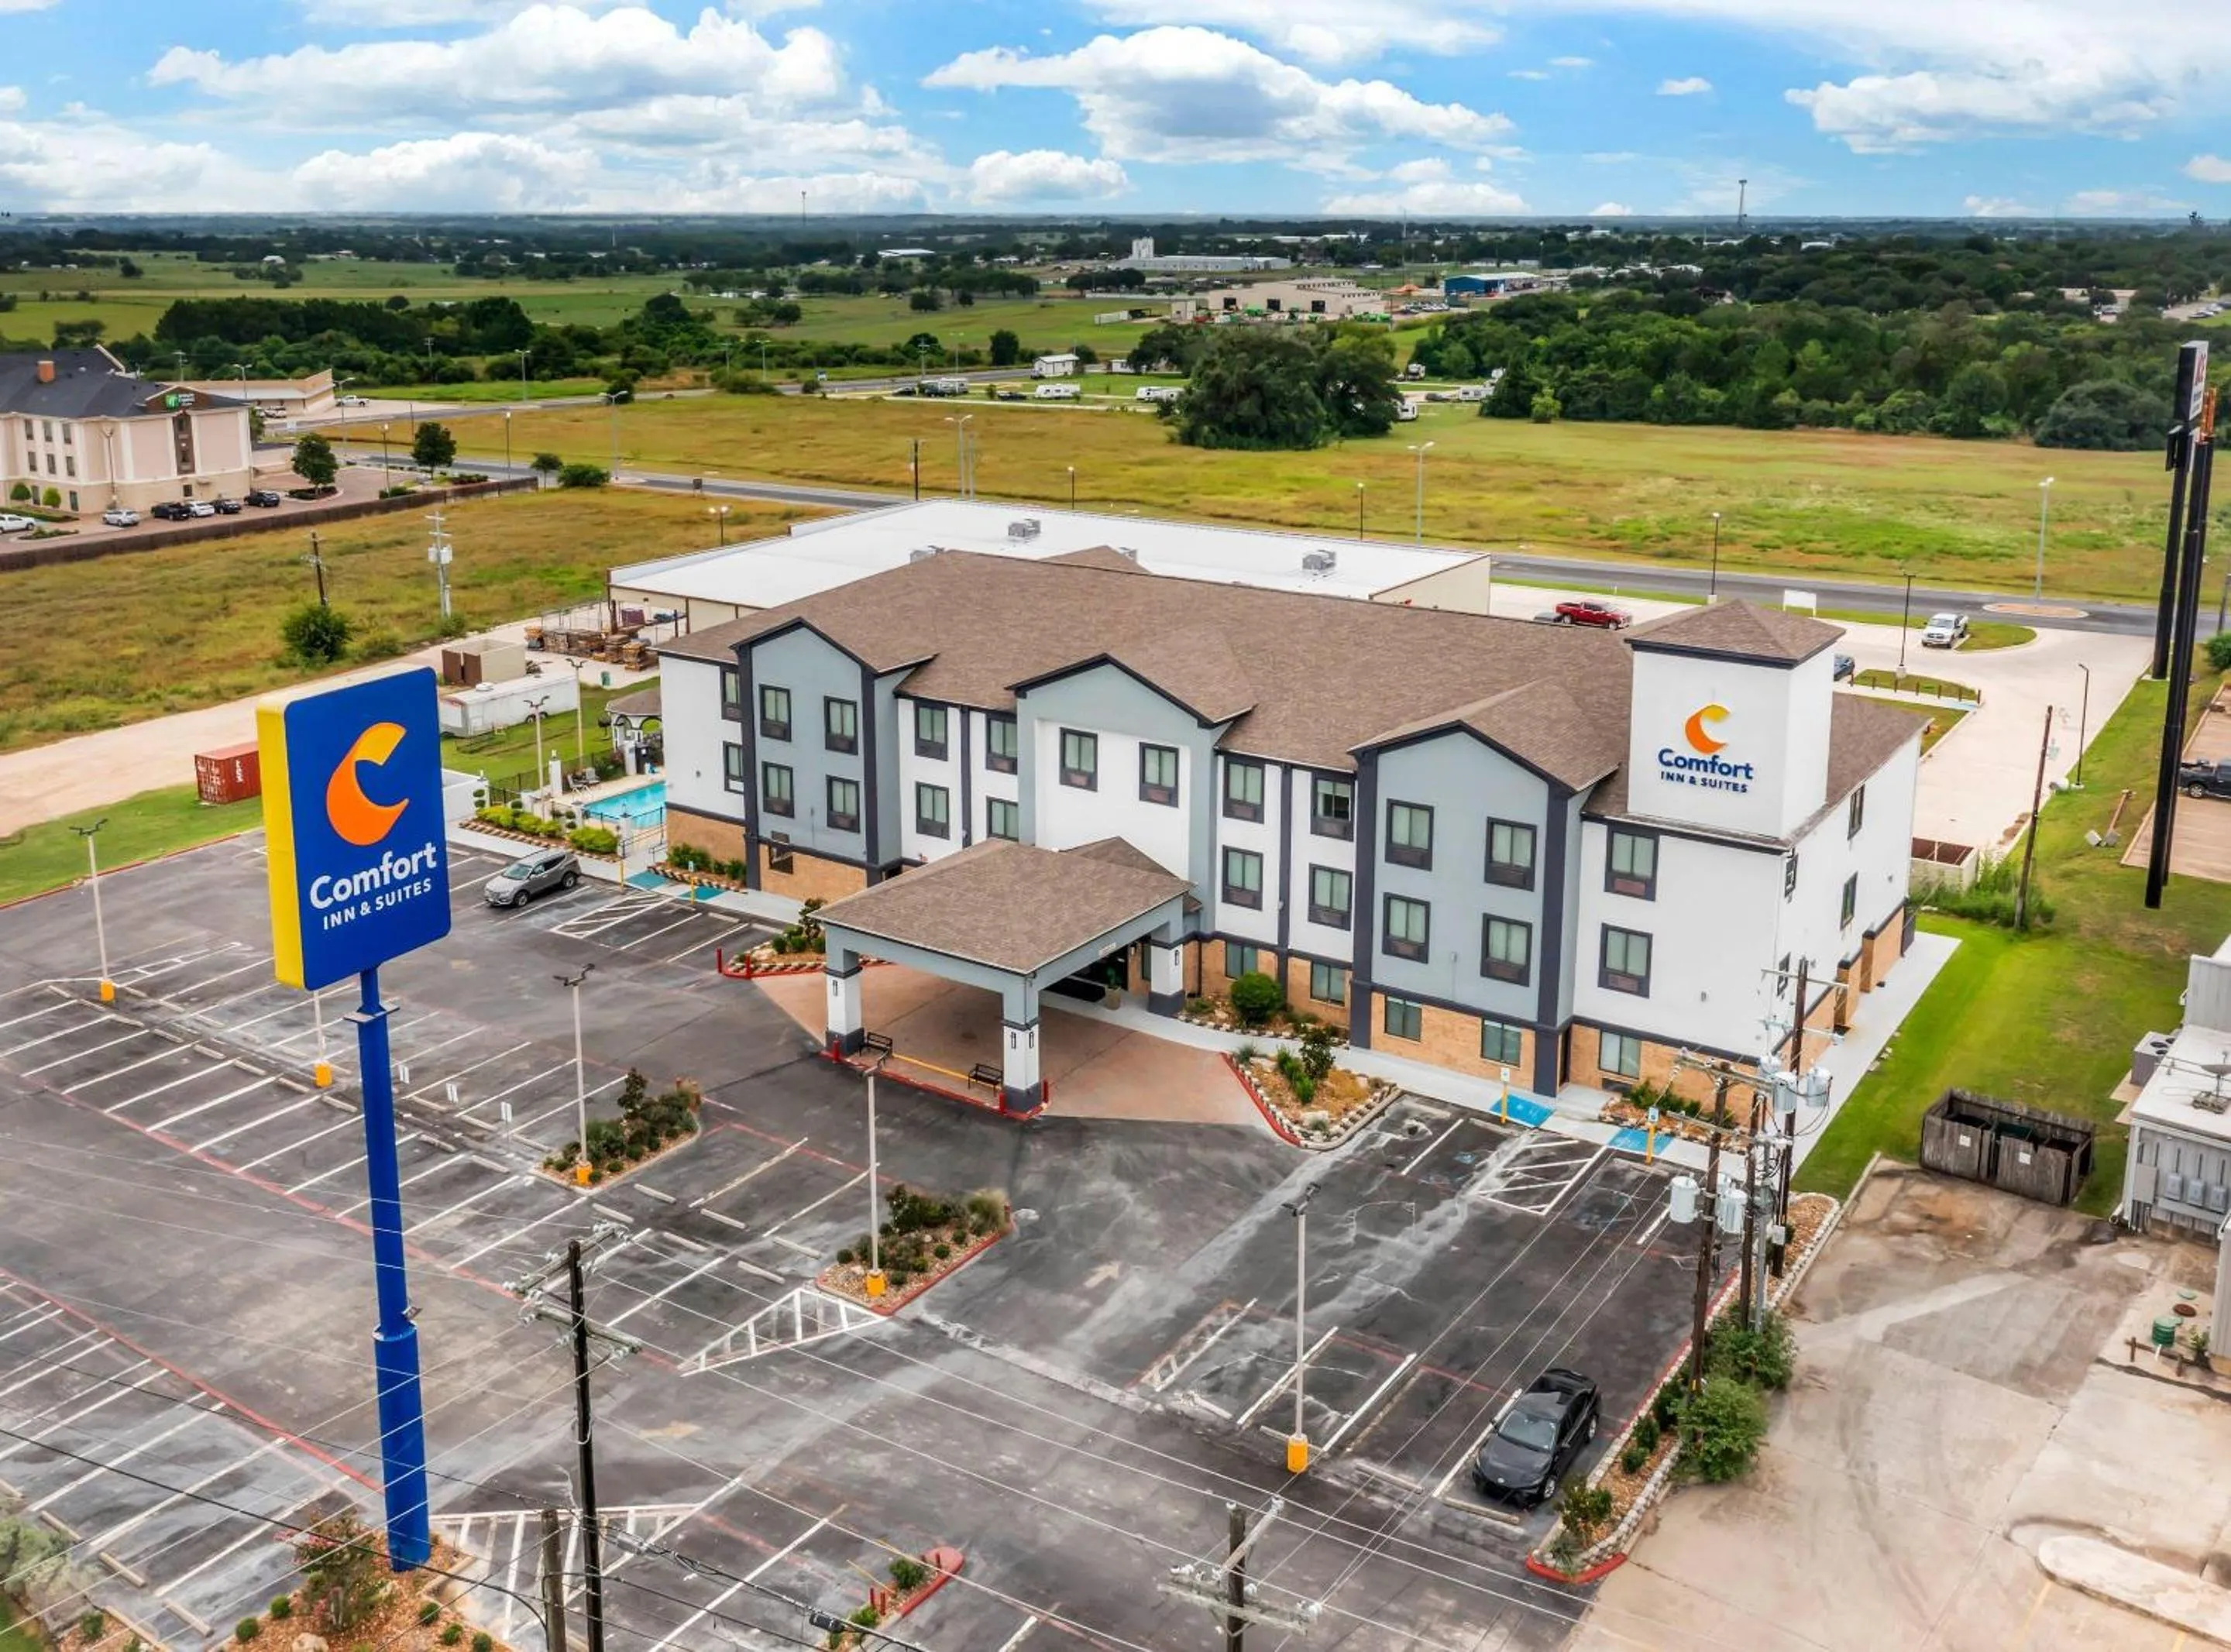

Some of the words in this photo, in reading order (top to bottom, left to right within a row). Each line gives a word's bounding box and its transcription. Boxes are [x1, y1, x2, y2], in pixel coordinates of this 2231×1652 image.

[1658, 748, 1753, 780] Comfort
[1661, 771, 1685, 782] INN
[1689, 775, 1696, 785] &
[1700, 777, 1748, 793] SUITES
[310, 842, 437, 909] Comfort
[323, 906, 356, 930] INN
[359, 902, 372, 916] &
[375, 878, 431, 911] SUITES
